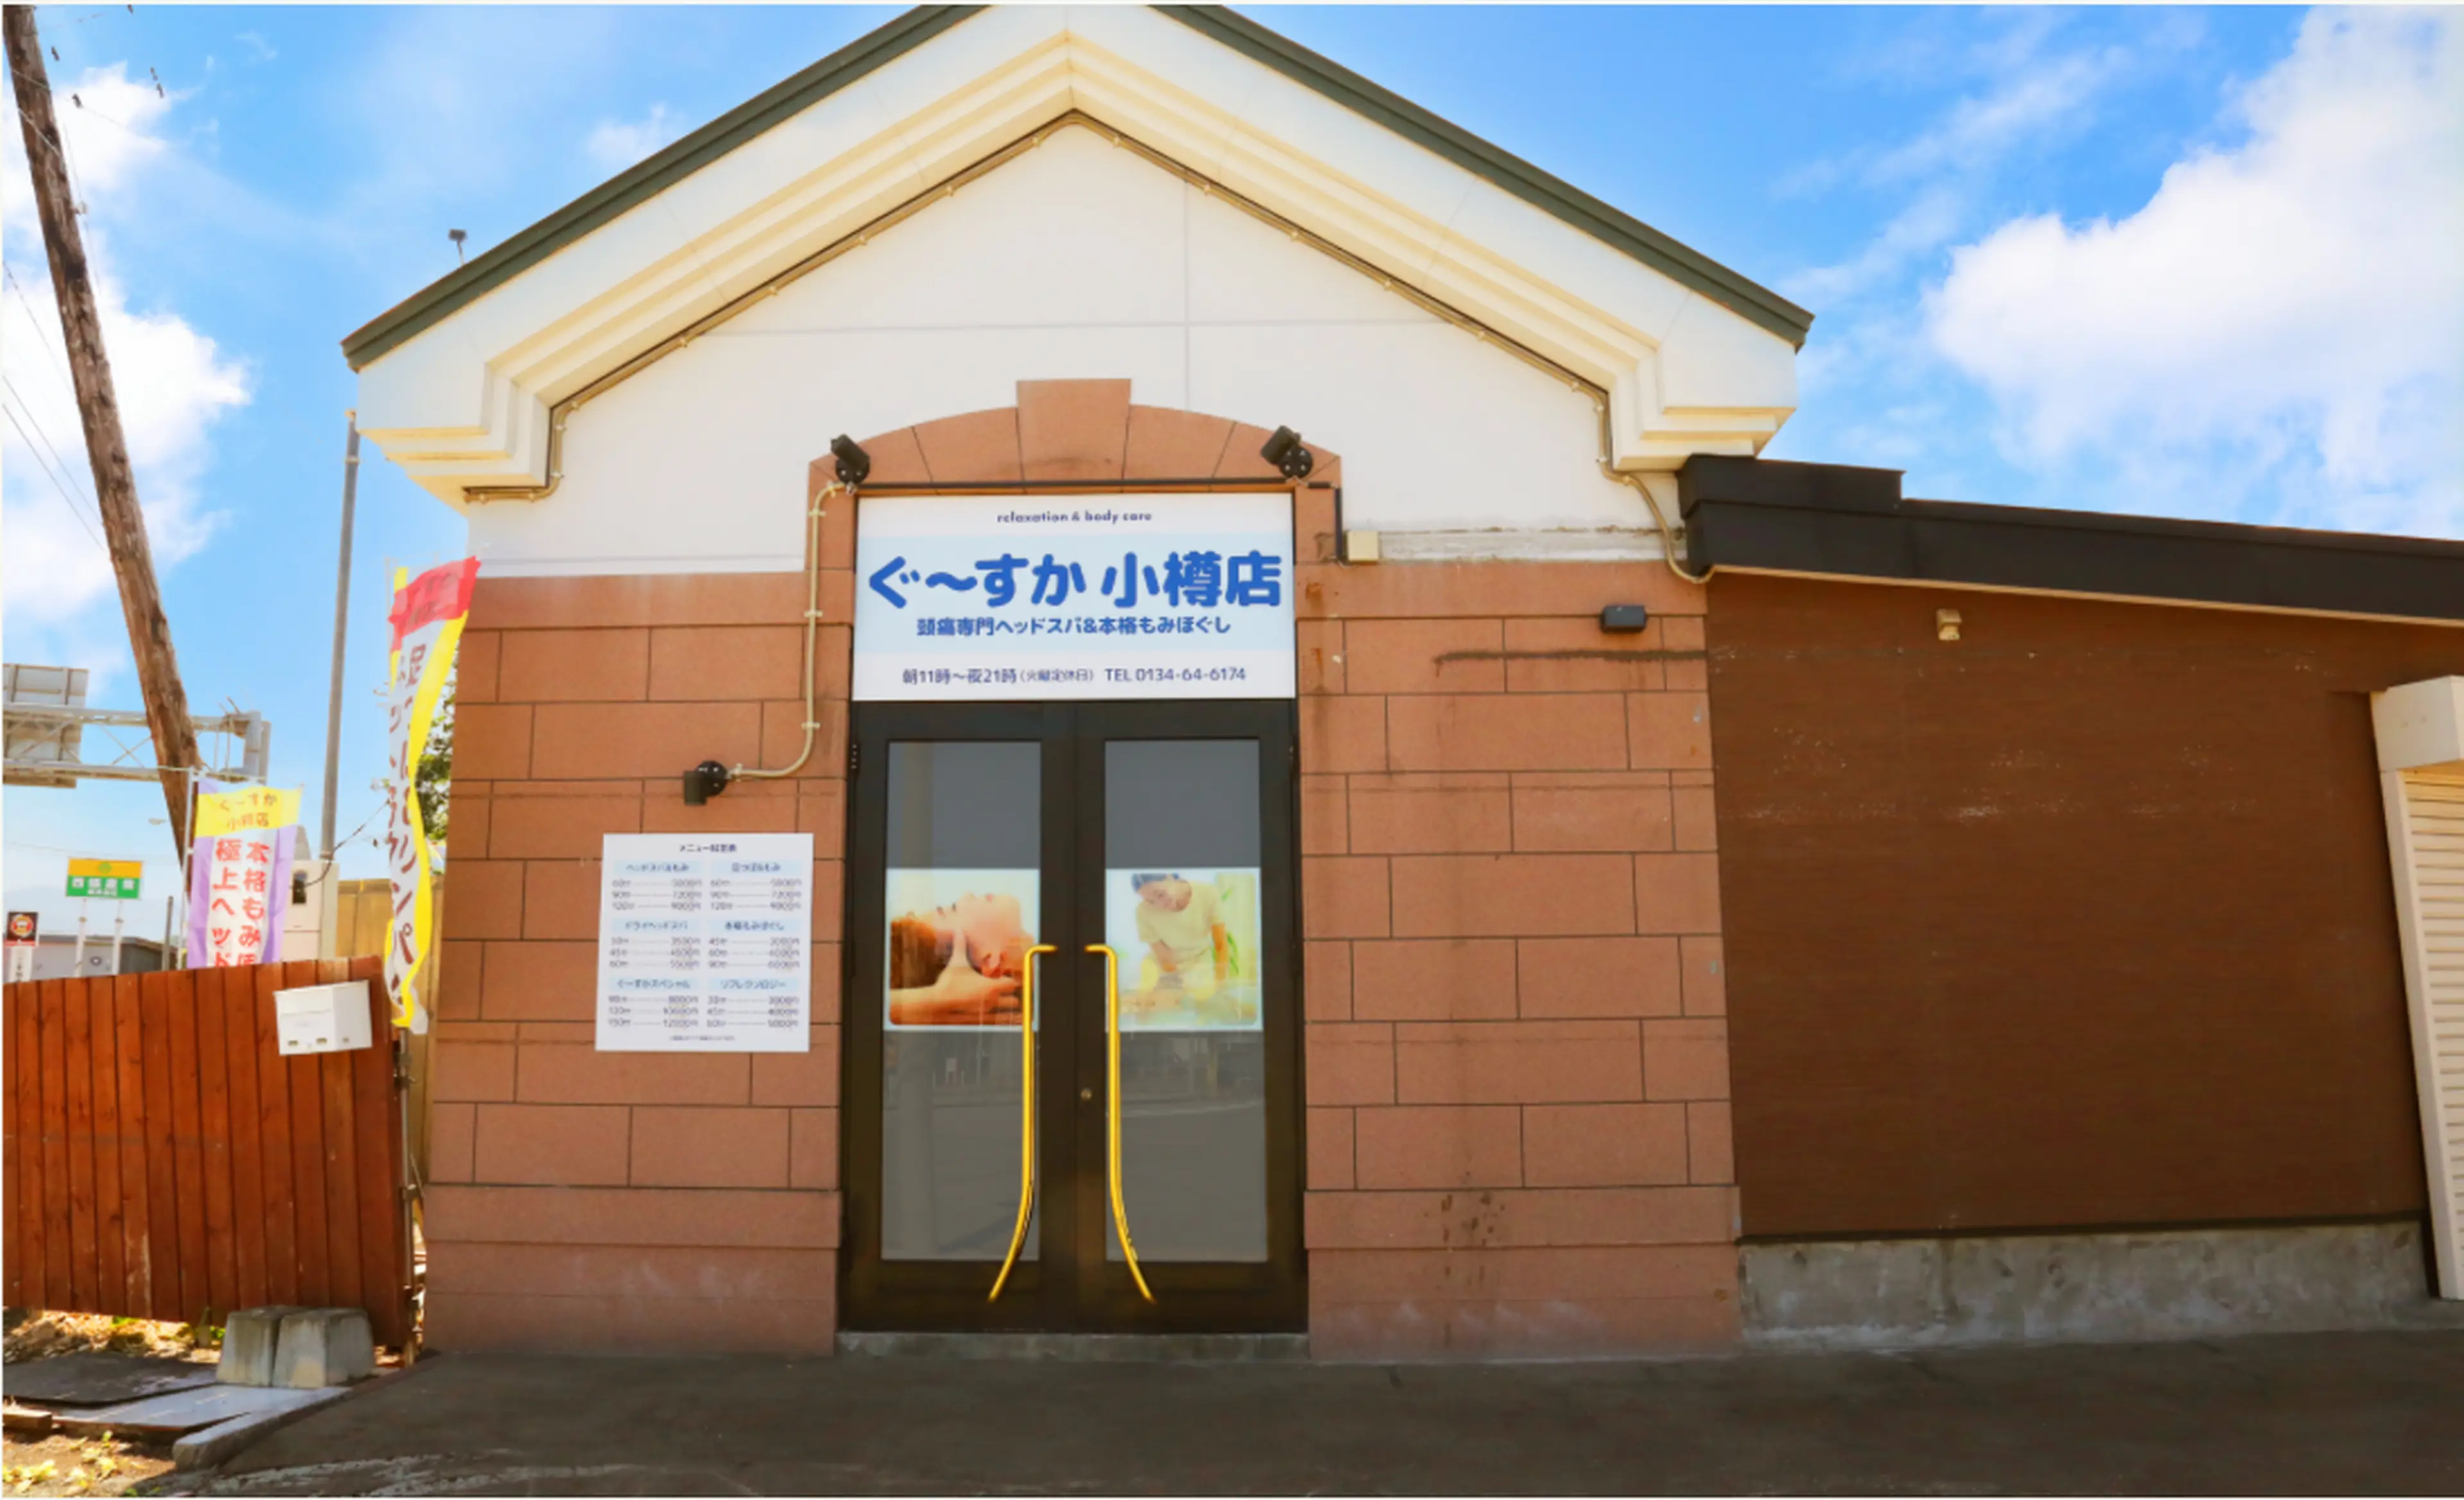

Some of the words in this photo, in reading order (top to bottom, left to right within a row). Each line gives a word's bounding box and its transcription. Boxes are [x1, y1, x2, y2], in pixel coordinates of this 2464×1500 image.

[997, 511, 1068, 523] relaxation
[1071, 512, 1081, 522] &
[1084, 511, 1118, 524] body
[1122, 513, 1152, 522] care
[1100, 549, 1282, 609] 小樽店
[1105, 669, 1131, 682] TEL
